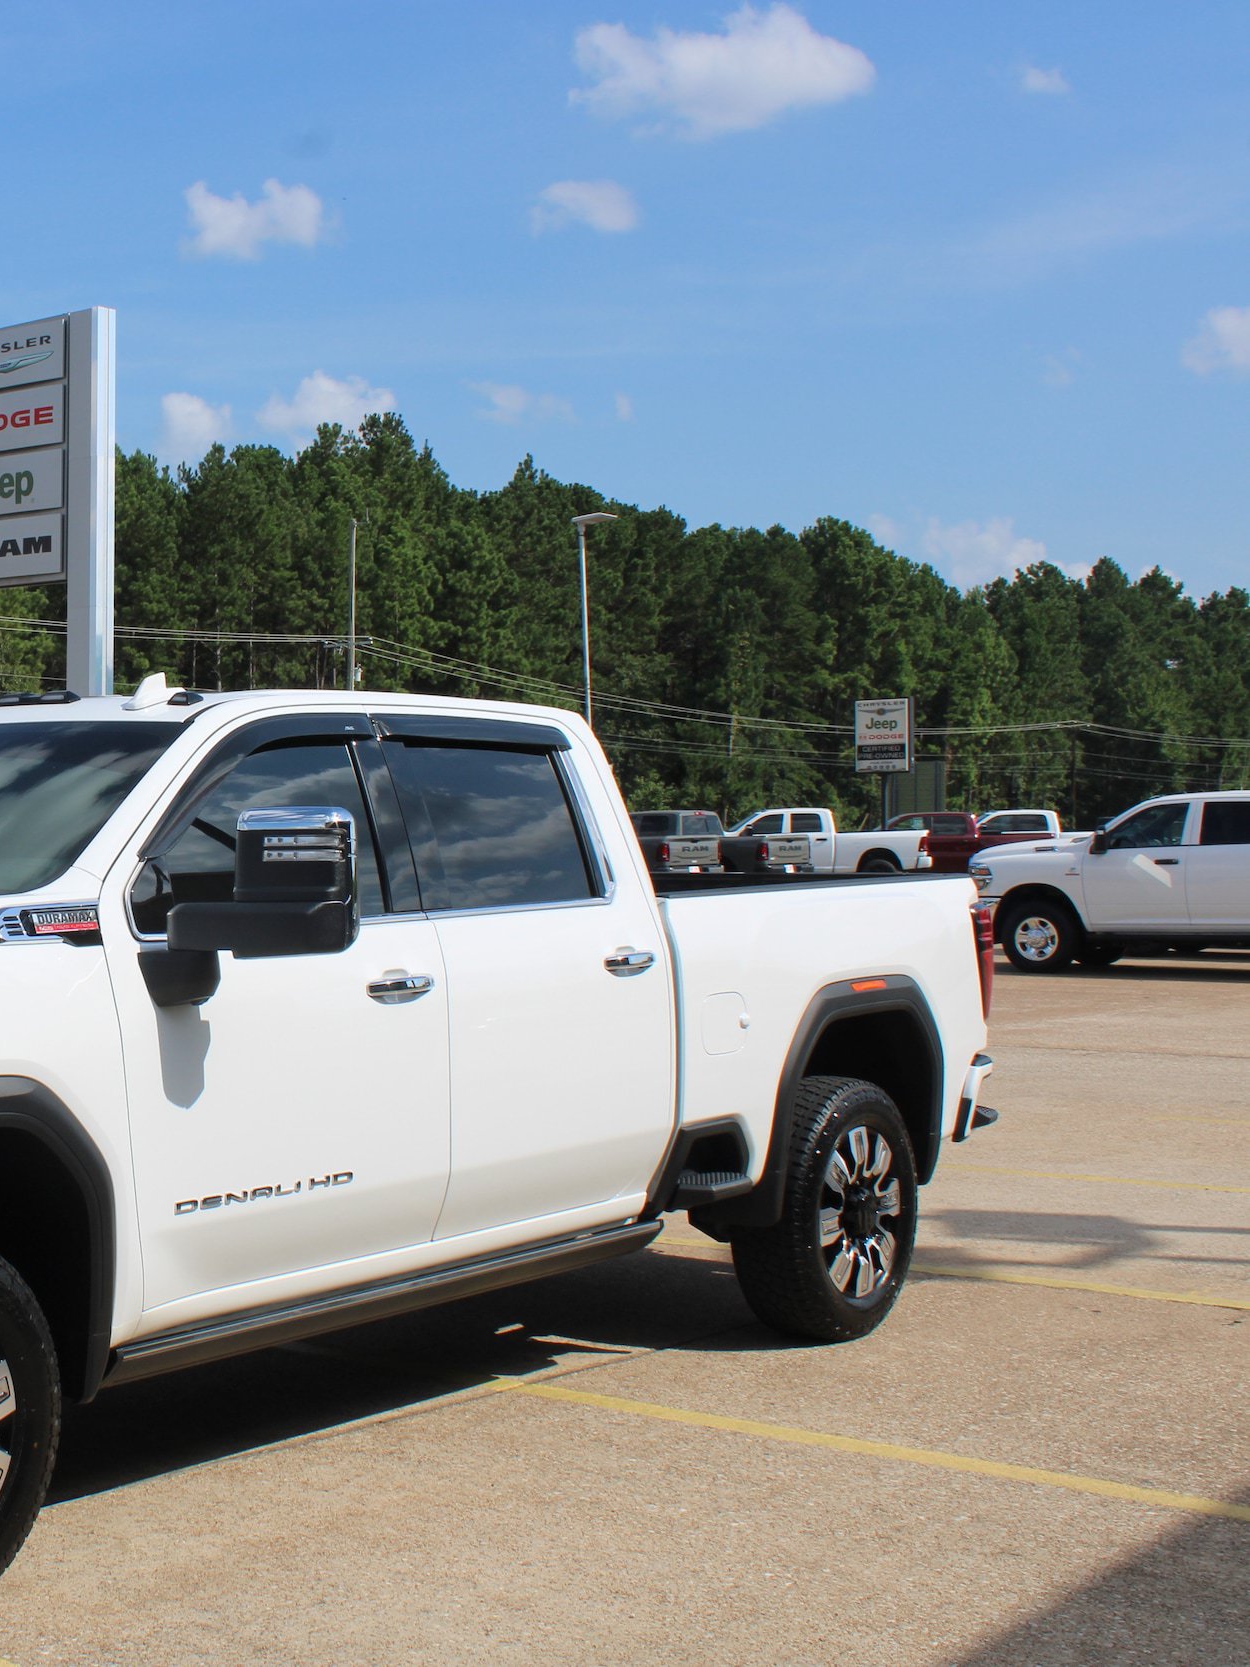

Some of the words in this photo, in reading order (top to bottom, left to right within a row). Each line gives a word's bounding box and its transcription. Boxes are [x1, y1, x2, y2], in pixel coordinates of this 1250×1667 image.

[865, 717, 898, 731] Jeep
[861, 745, 901, 753] CERTIFIED
[681, 845, 709, 853] RAM
[778, 844, 803, 852] RAM
[36, 911, 93, 925] DURAMAX
[173, 1180, 302, 1216] DENALI
[308, 1171, 354, 1191] HD
